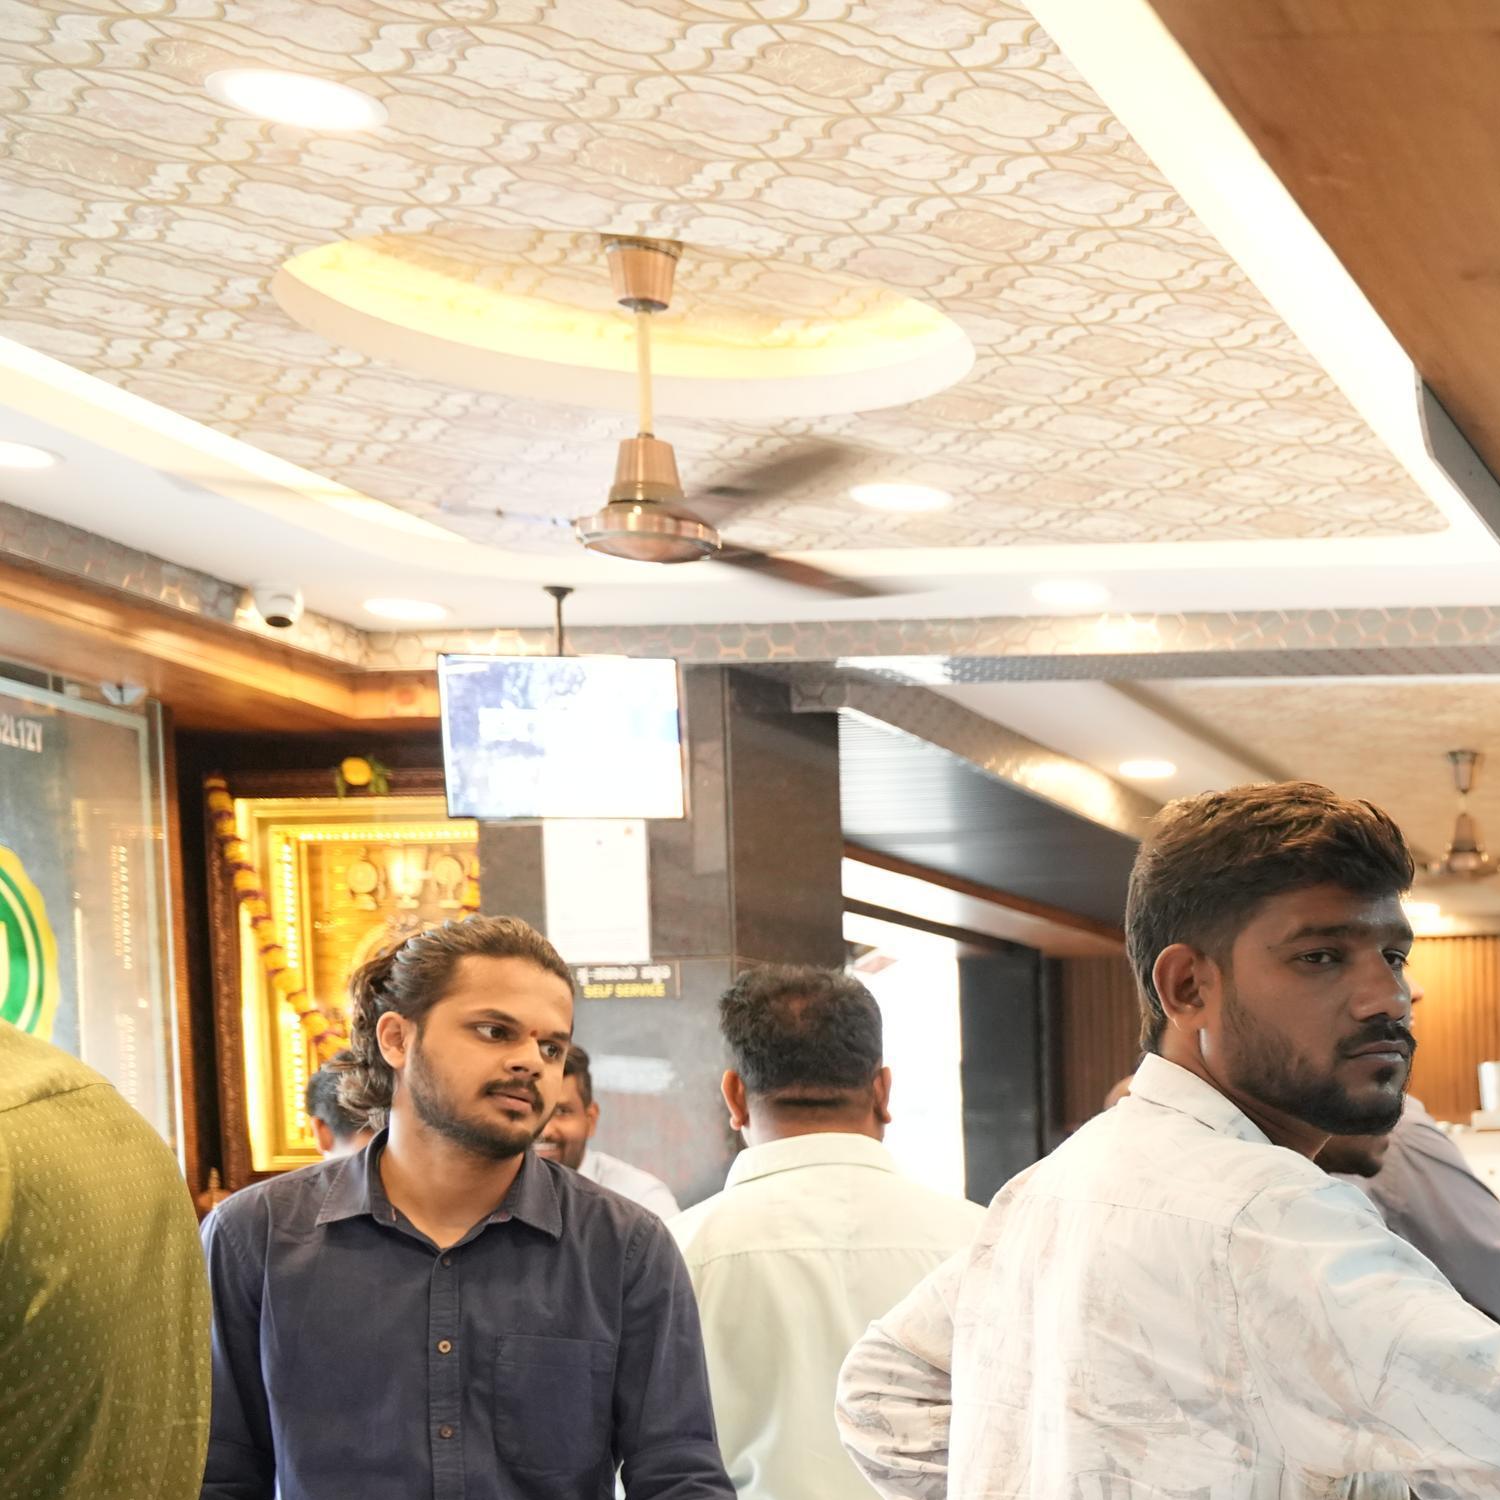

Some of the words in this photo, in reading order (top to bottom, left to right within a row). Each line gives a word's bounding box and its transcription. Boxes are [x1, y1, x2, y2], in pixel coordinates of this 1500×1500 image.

[0, 712, 43, 754] 2L1ZY
[583, 983, 613, 999] SELF
[615, 982, 666, 998] SERVICE
